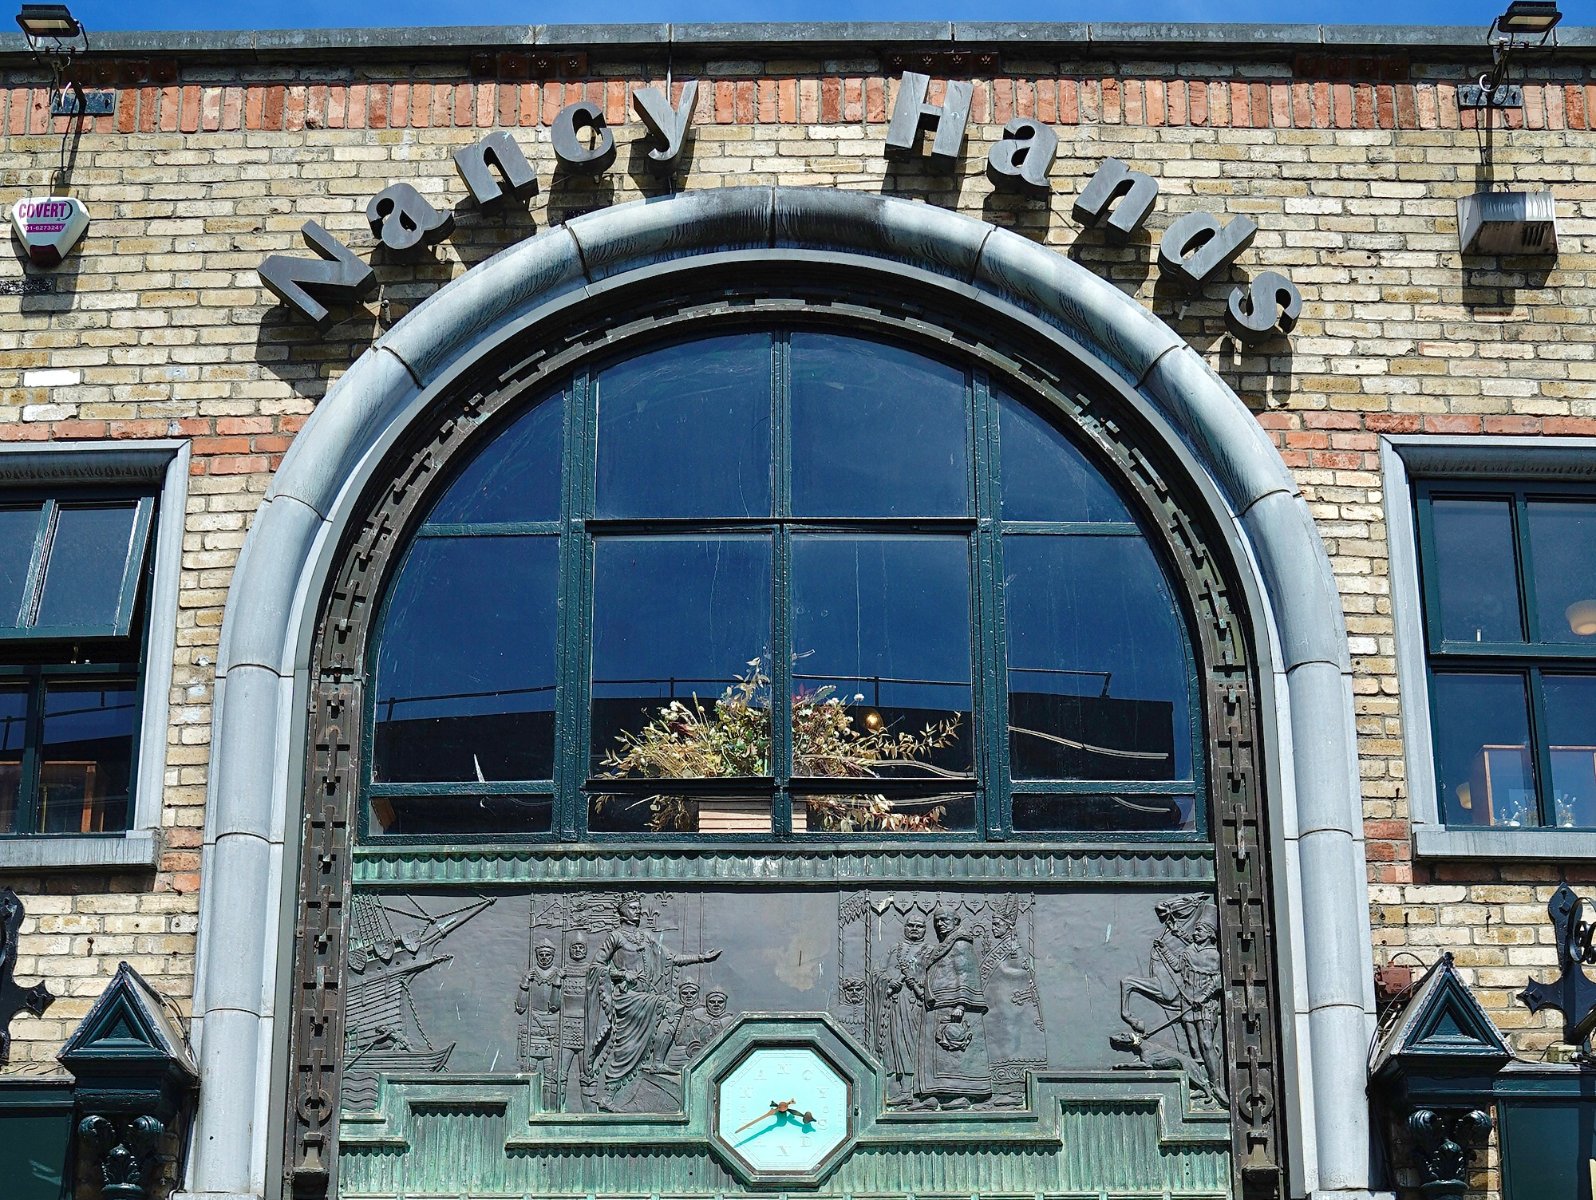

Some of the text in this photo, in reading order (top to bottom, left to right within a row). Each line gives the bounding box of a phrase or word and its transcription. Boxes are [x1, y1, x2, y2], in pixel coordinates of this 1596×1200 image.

[19, 202, 67, 218] COVERT
[258, 71, 1302, 345] Nancy Hands
